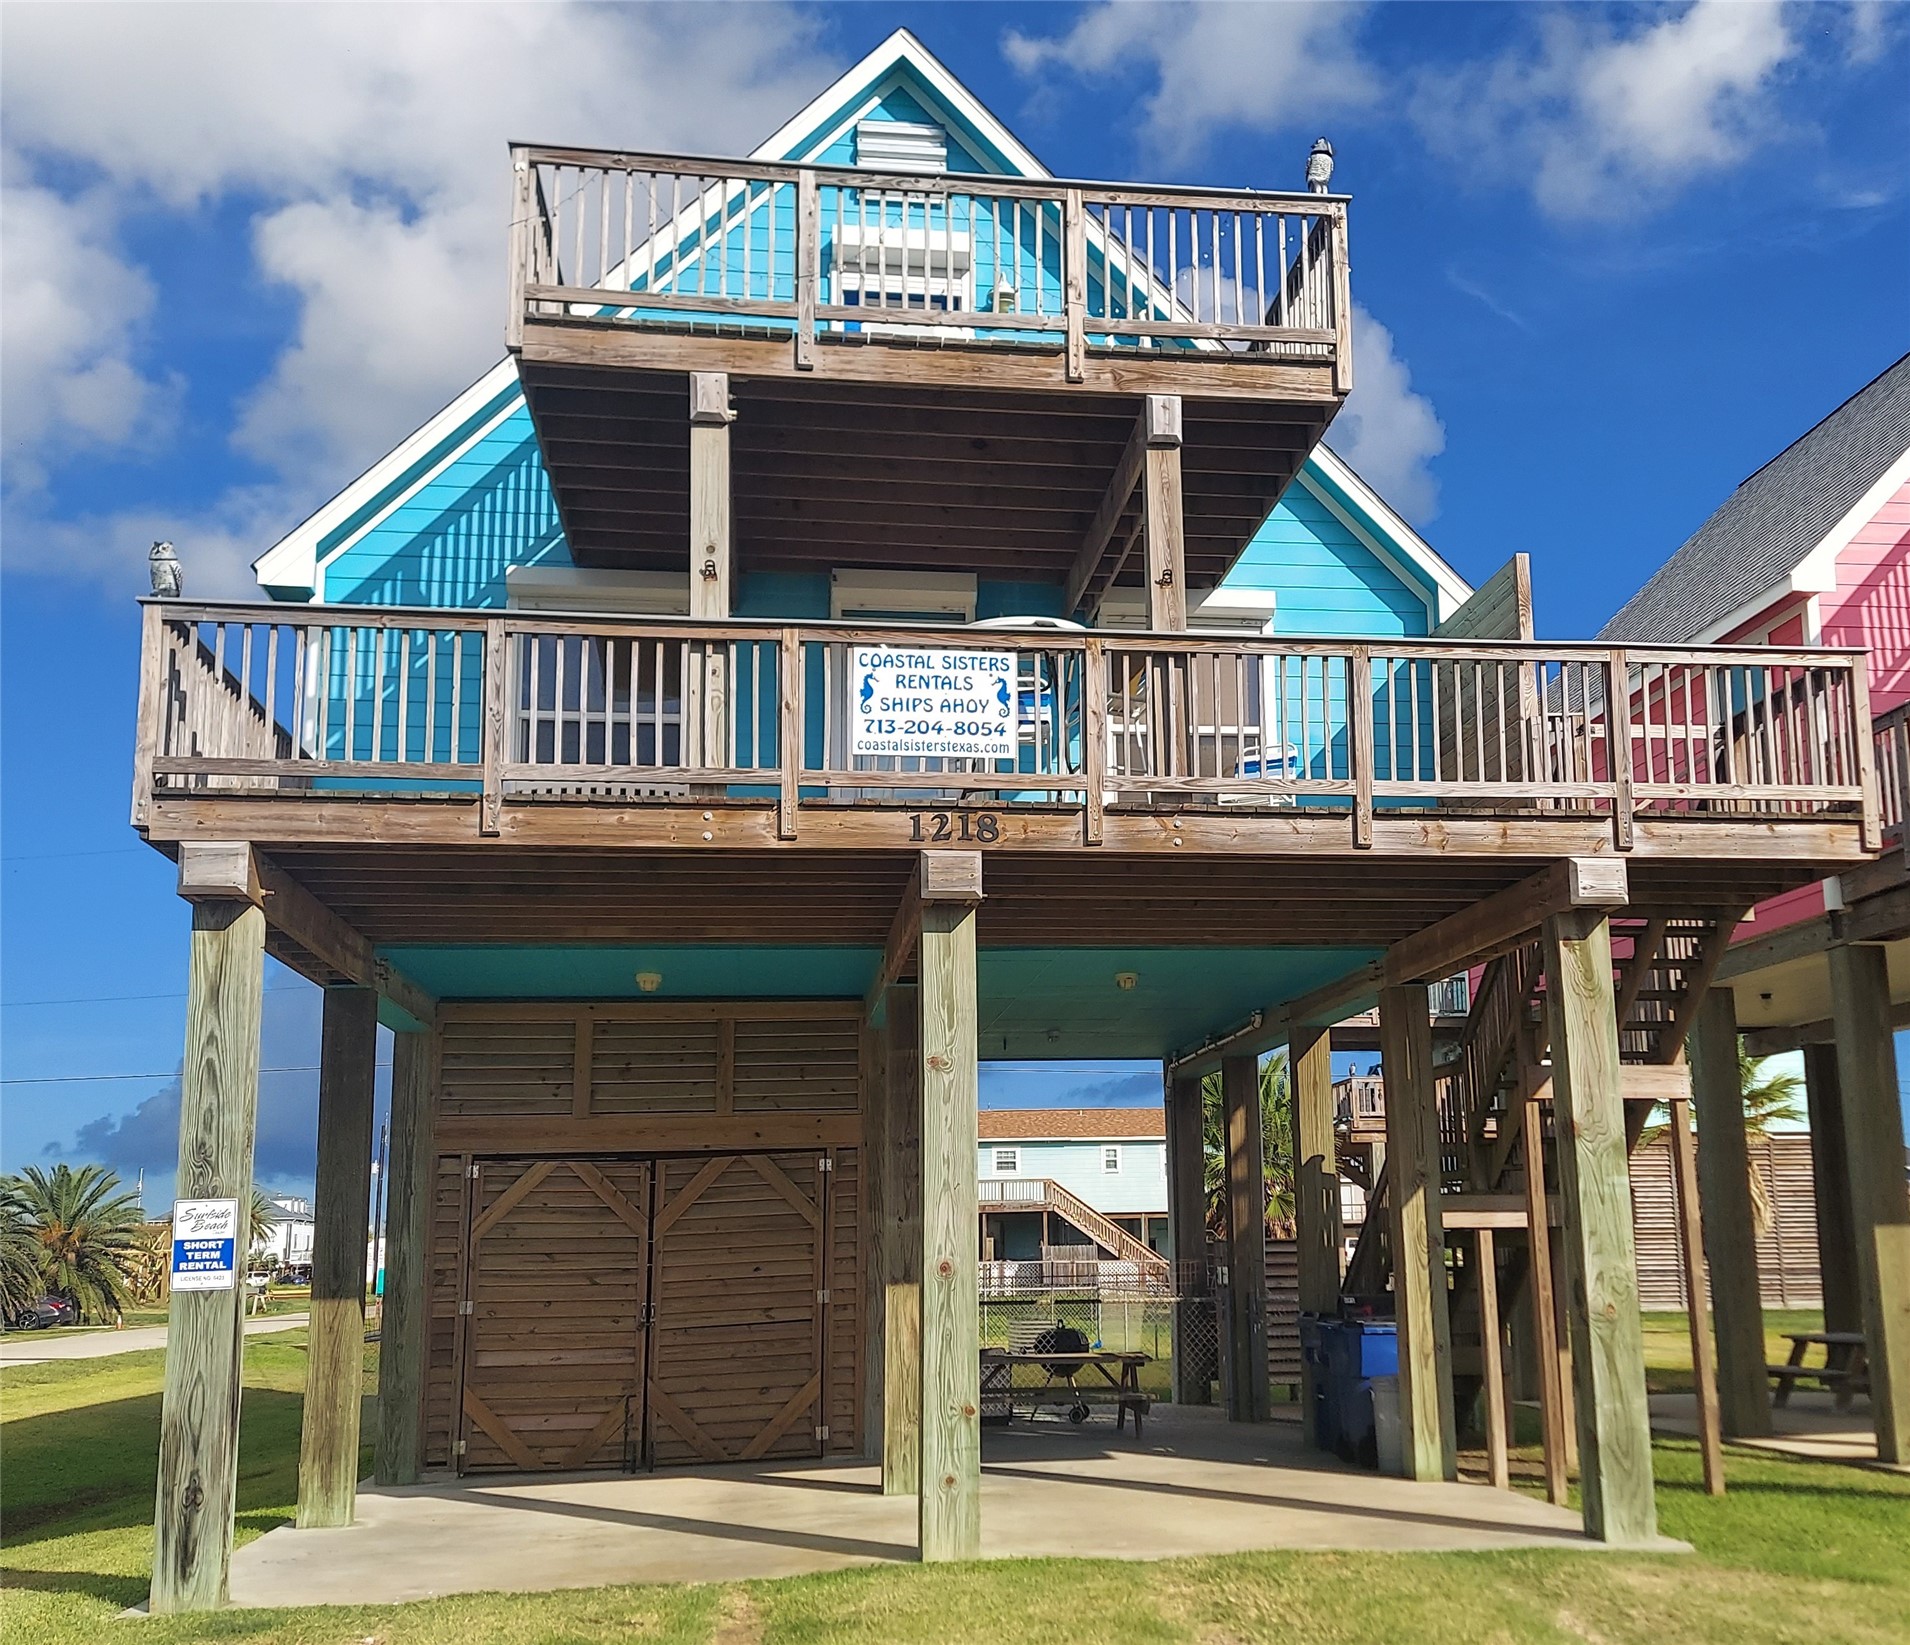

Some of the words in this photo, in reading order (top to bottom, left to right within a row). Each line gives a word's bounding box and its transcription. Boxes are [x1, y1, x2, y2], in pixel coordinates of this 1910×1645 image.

[859, 653, 935, 670] COASTAL
[942, 655, 1010, 672] SISTERS
[895, 674, 974, 691] RENTALS
[879, 697, 934, 713] SHIPS
[940, 698, 990, 714] AHOY
[863, 719, 1007, 737] 713-204-8054
[857, 738, 1010, 754] coastalsisterstexas.com
[908, 813, 1000, 843] 1218
[179, 1208, 232, 1222] Surfside
[190, 1219, 229, 1232] Beach
[183, 1241, 224, 1250] SHORT
[186, 1251, 220, 1260] TERM
[179, 1261, 227, 1270] RENTAL
